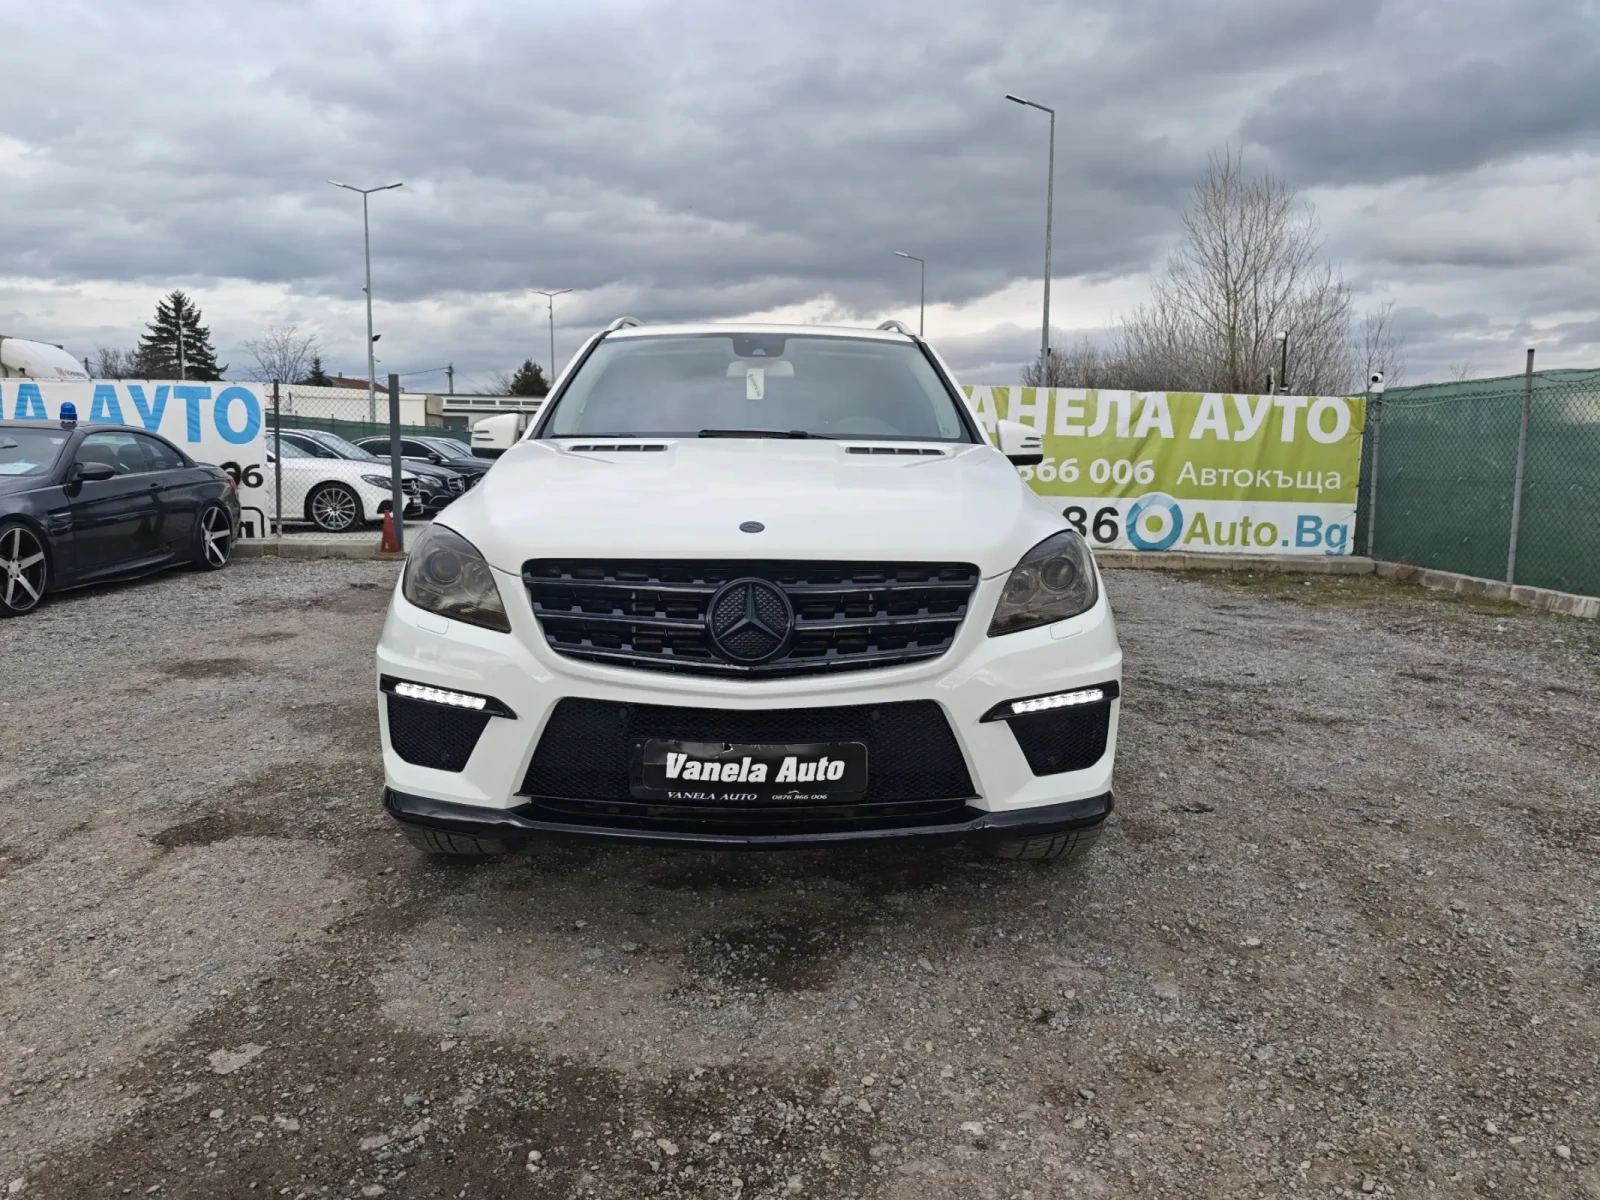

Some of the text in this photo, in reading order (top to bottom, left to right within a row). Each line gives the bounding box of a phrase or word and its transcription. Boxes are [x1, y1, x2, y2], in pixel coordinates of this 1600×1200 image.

[1189, 393, 1350, 444] АУТО
[1089, 458, 1155, 485] 006
[1176, 461, 1341, 493] Автокъща
[1183, 512, 1348, 556] Auto.Bg
[665, 752, 845, 783] Vanela Auto
[667, 791, 758, 801] VANELA AUTO
